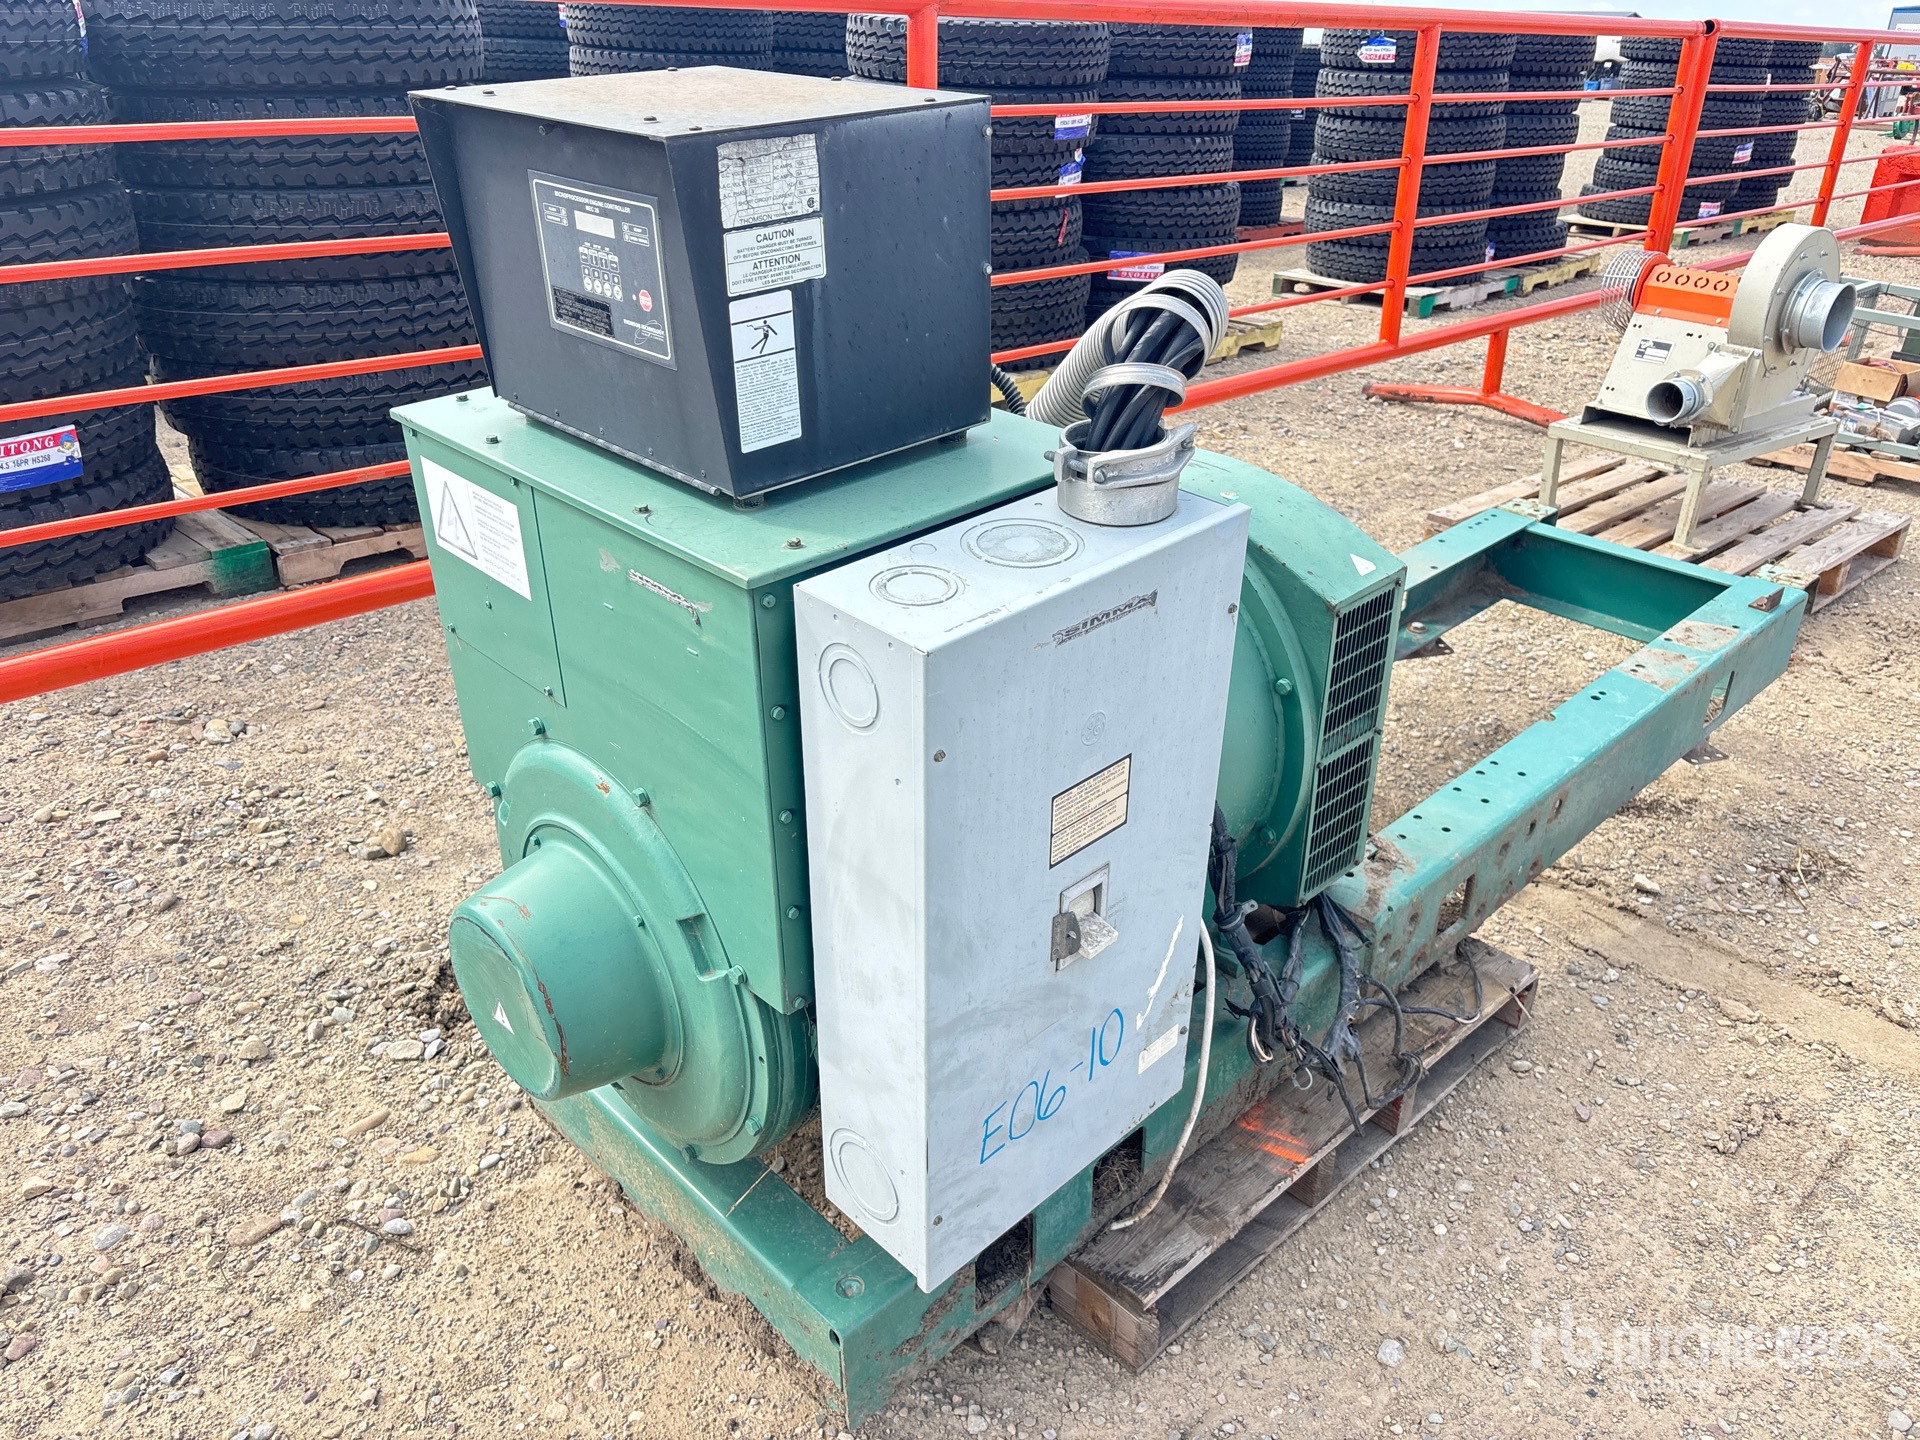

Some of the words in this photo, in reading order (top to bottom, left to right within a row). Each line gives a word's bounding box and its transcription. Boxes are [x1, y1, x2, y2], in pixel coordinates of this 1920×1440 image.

[589, 198, 605, 208] ENGINE
[604, 201, 631, 214] CONTROLLER
[740, 213, 773, 225] THOMSON
[755, 227, 795, 243] CAUTION
[736, 246, 756, 254] BATTERY
[756, 243, 777, 251] CHARGER
[796, 235, 813, 244] TURNED
[742, 251, 759, 259] BEFORE
[760, 245, 795, 256] DISCONNECTING
[795, 240, 817, 250] BATTERIES
[752, 252, 801, 271] ATTENTION
[748, 269, 773, 278] CHARGEUR
[769, 271, 784, 279] AVANT
[770, 275, 794, 285] BATTERIES
[12, 458, 30, 468] 16PR
[31, 453, 51, 465] HS268
[980, 1008, 1125, 1165] E06-10
